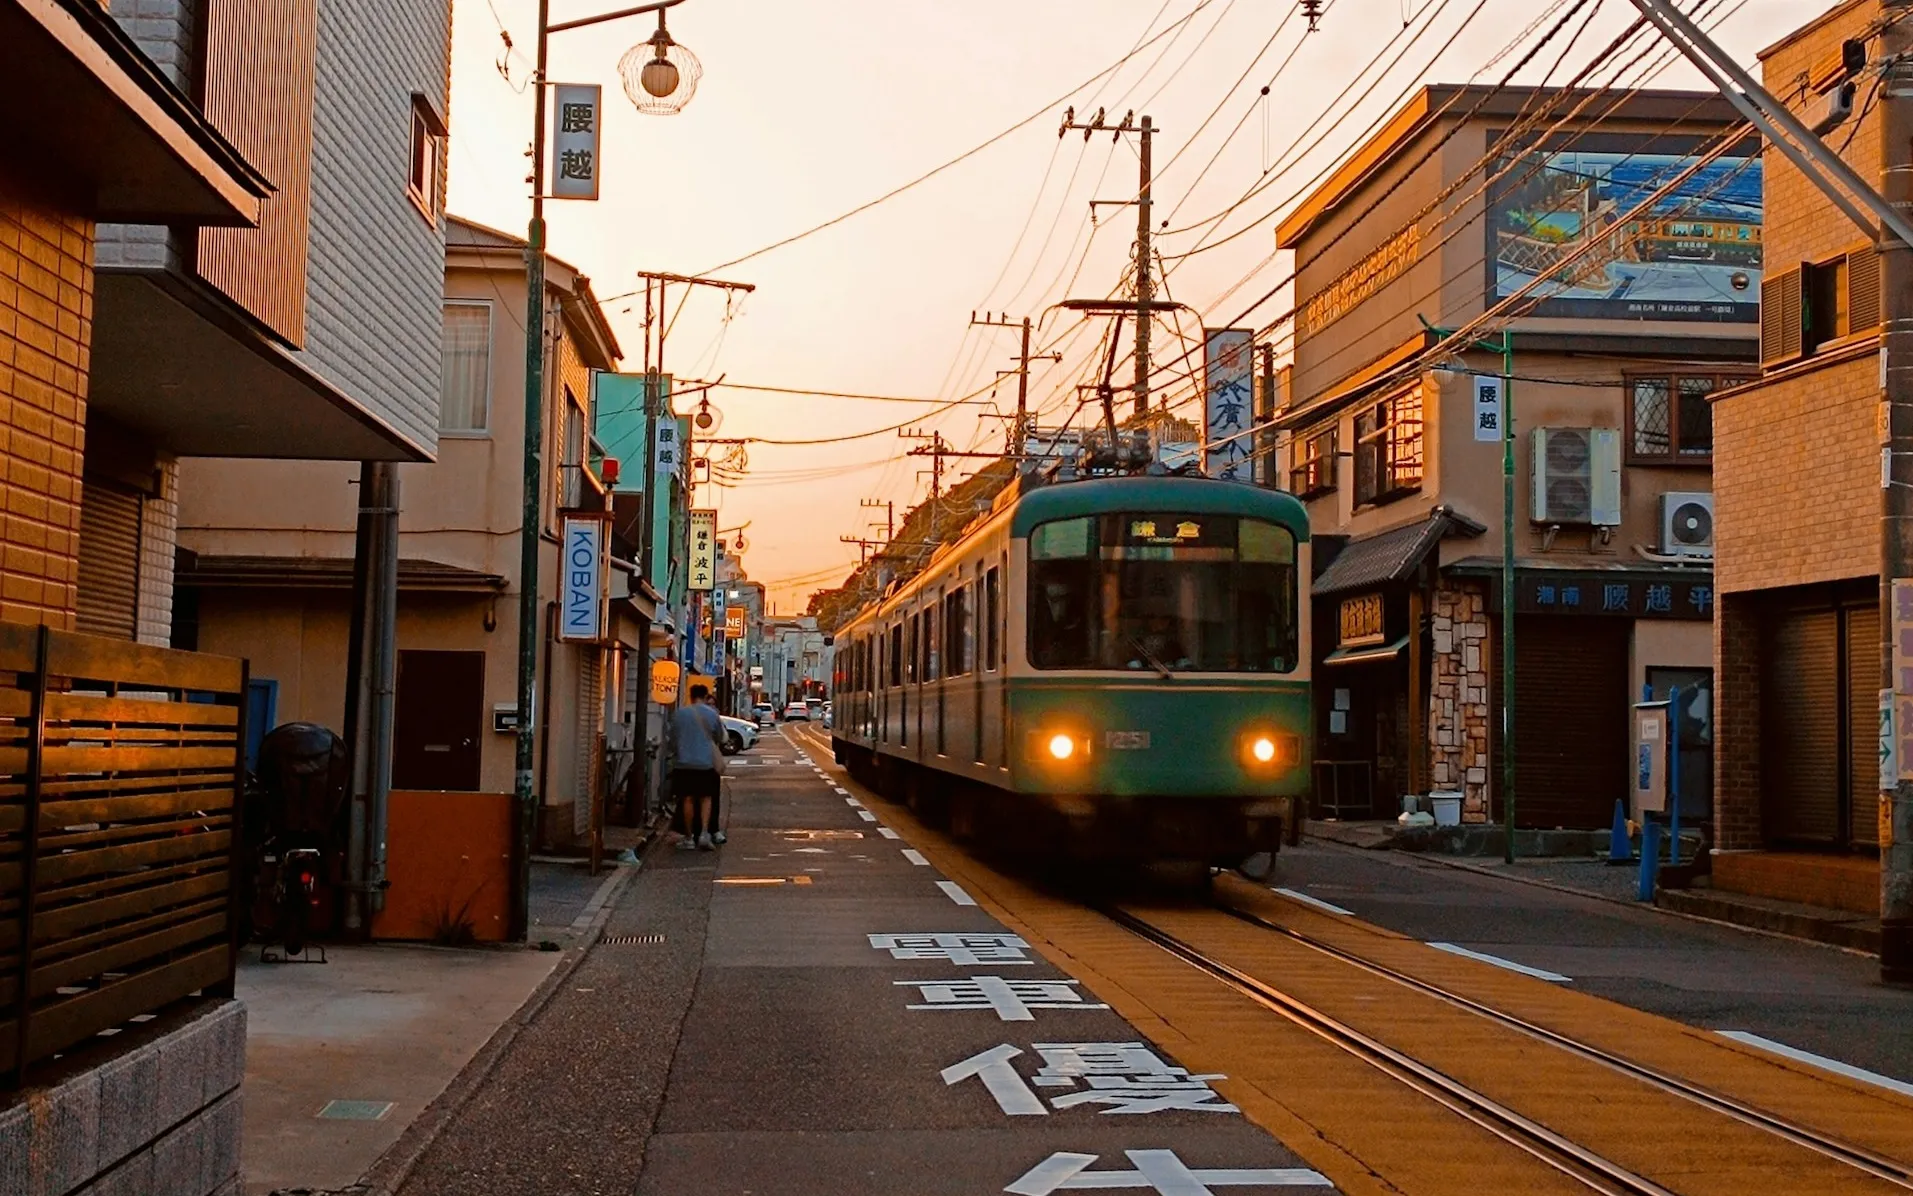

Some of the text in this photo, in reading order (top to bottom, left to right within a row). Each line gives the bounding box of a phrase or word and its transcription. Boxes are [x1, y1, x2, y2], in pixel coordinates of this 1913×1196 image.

[561, 103, 593, 180] 腰越
[1480, 386, 1497, 429] 腰越
[659, 428, 673, 463] 腰越
[570, 531, 593, 626] KOBAN
[694, 530, 709, 585] 鎌倉波平
